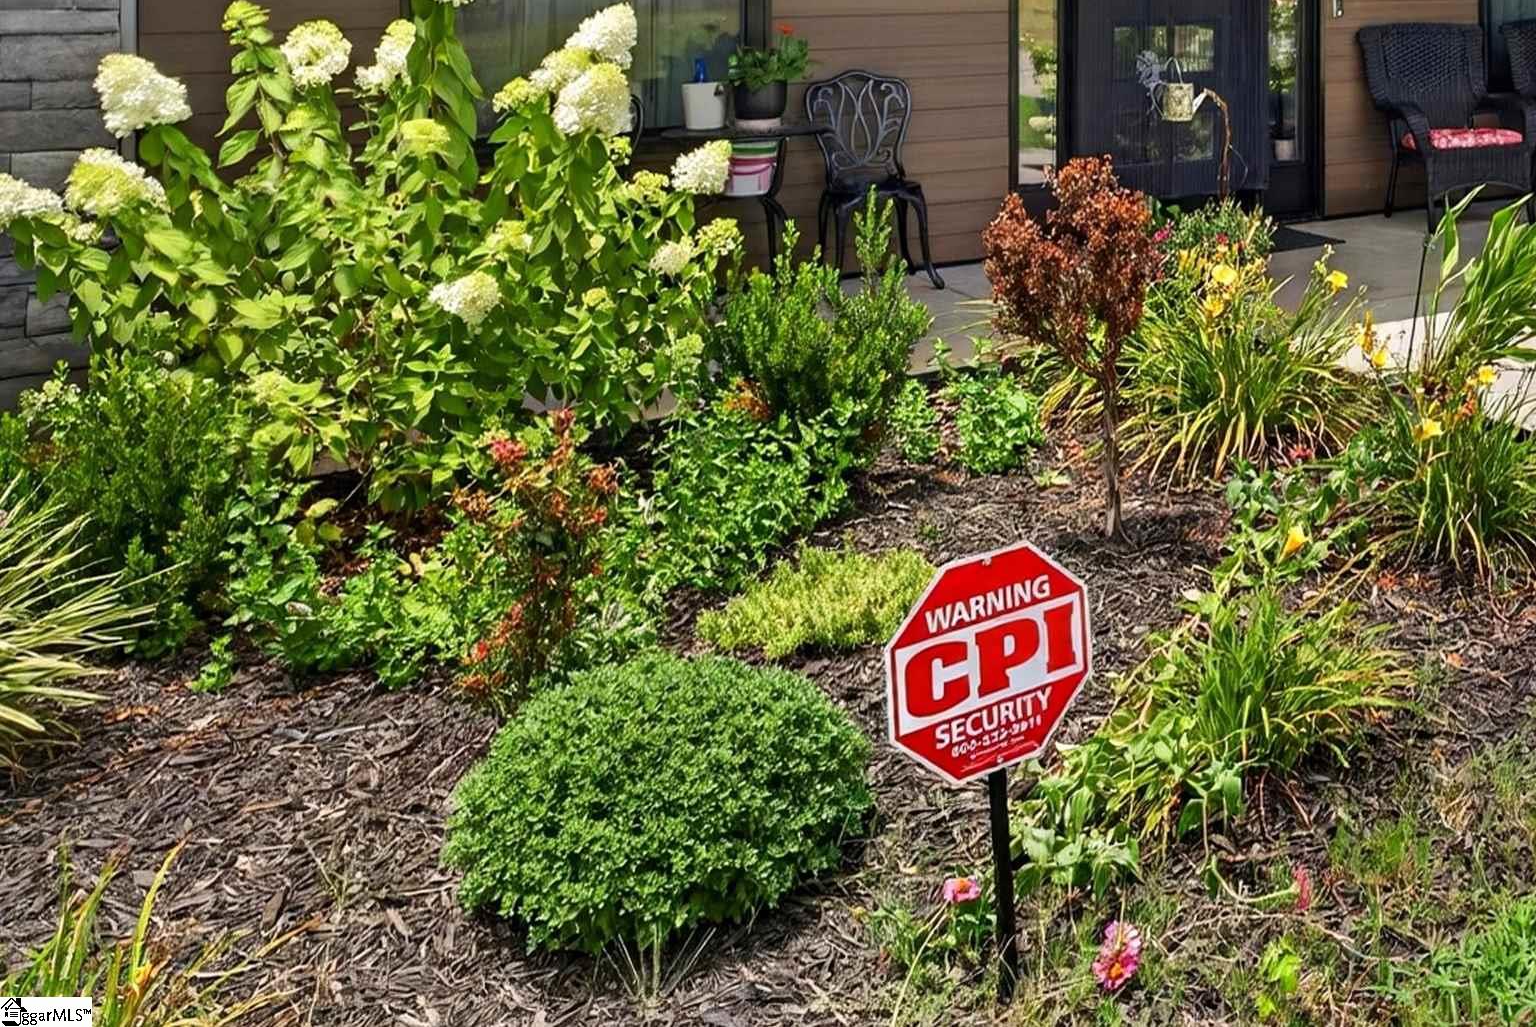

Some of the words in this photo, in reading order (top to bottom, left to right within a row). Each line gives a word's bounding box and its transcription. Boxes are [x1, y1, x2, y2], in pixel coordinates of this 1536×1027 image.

[925, 575, 1050, 634] WARNING
[905, 601, 1077, 718] CPI
[935, 685, 1052, 750] SECURITY
